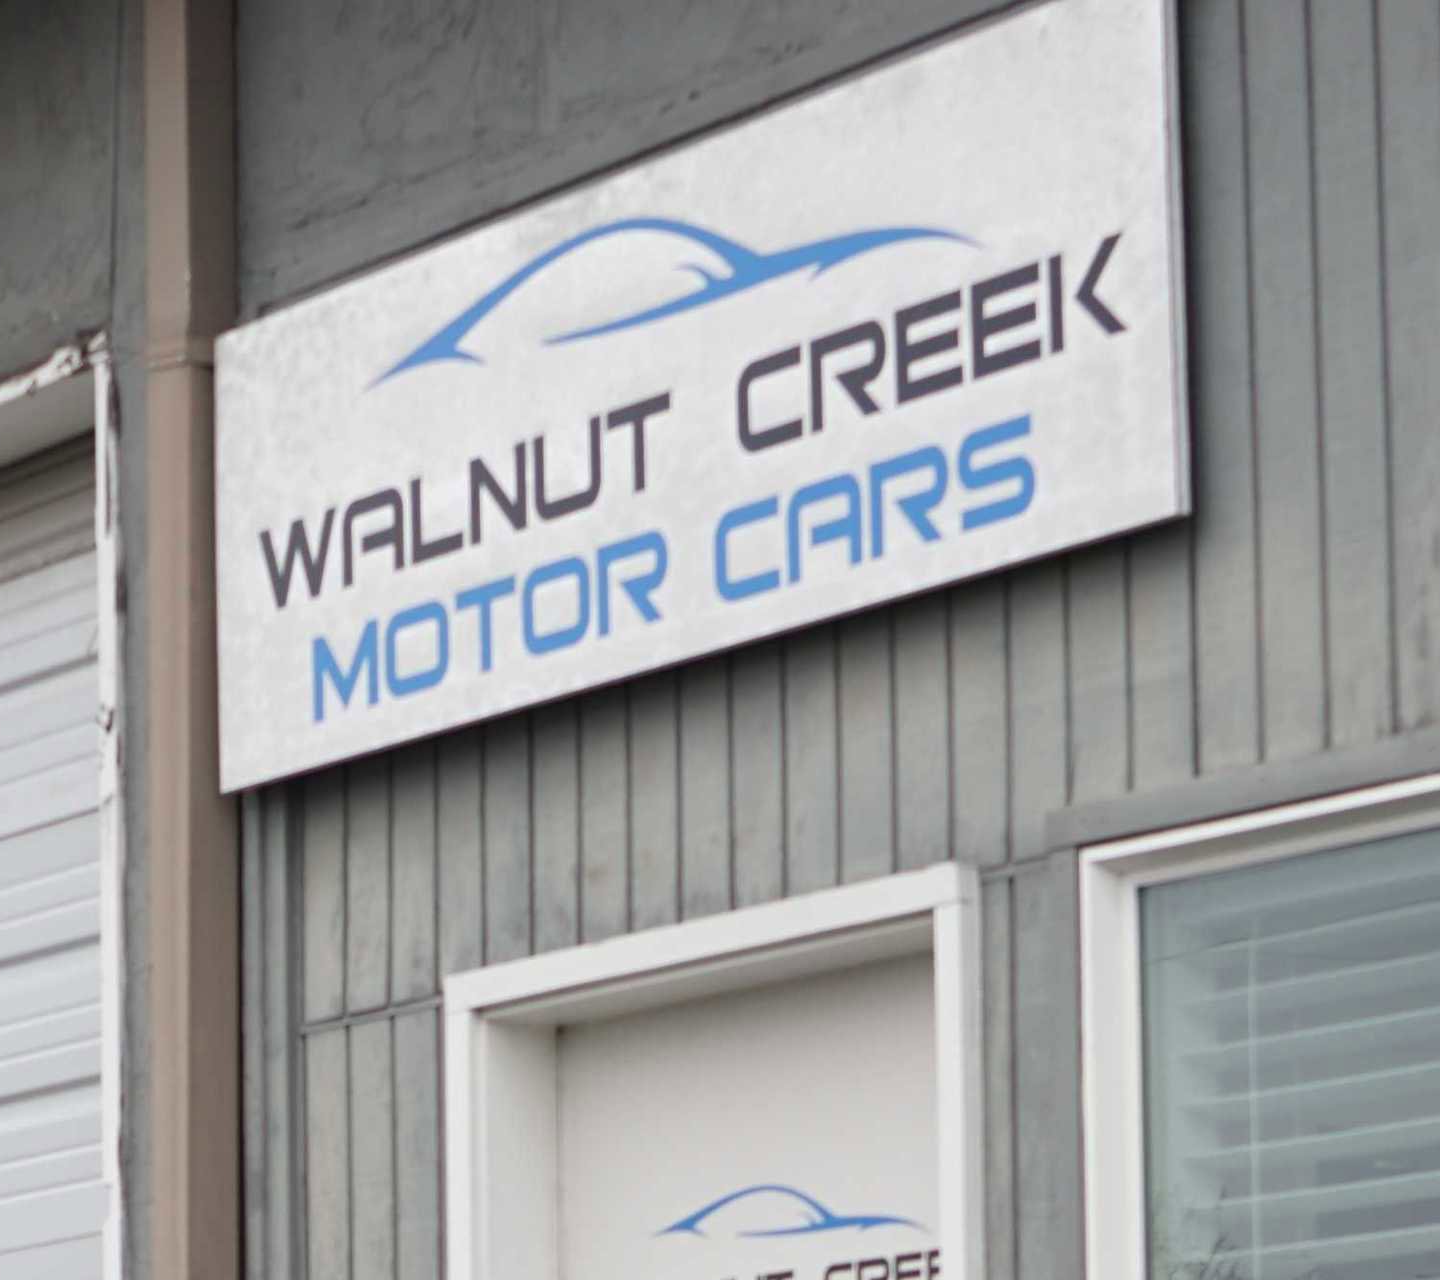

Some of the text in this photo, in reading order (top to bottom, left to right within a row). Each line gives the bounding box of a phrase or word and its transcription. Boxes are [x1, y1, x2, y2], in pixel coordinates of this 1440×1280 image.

[259, 232, 1127, 608] WALNUT CREEK
[312, 415, 1036, 721] MOTOR CARS
